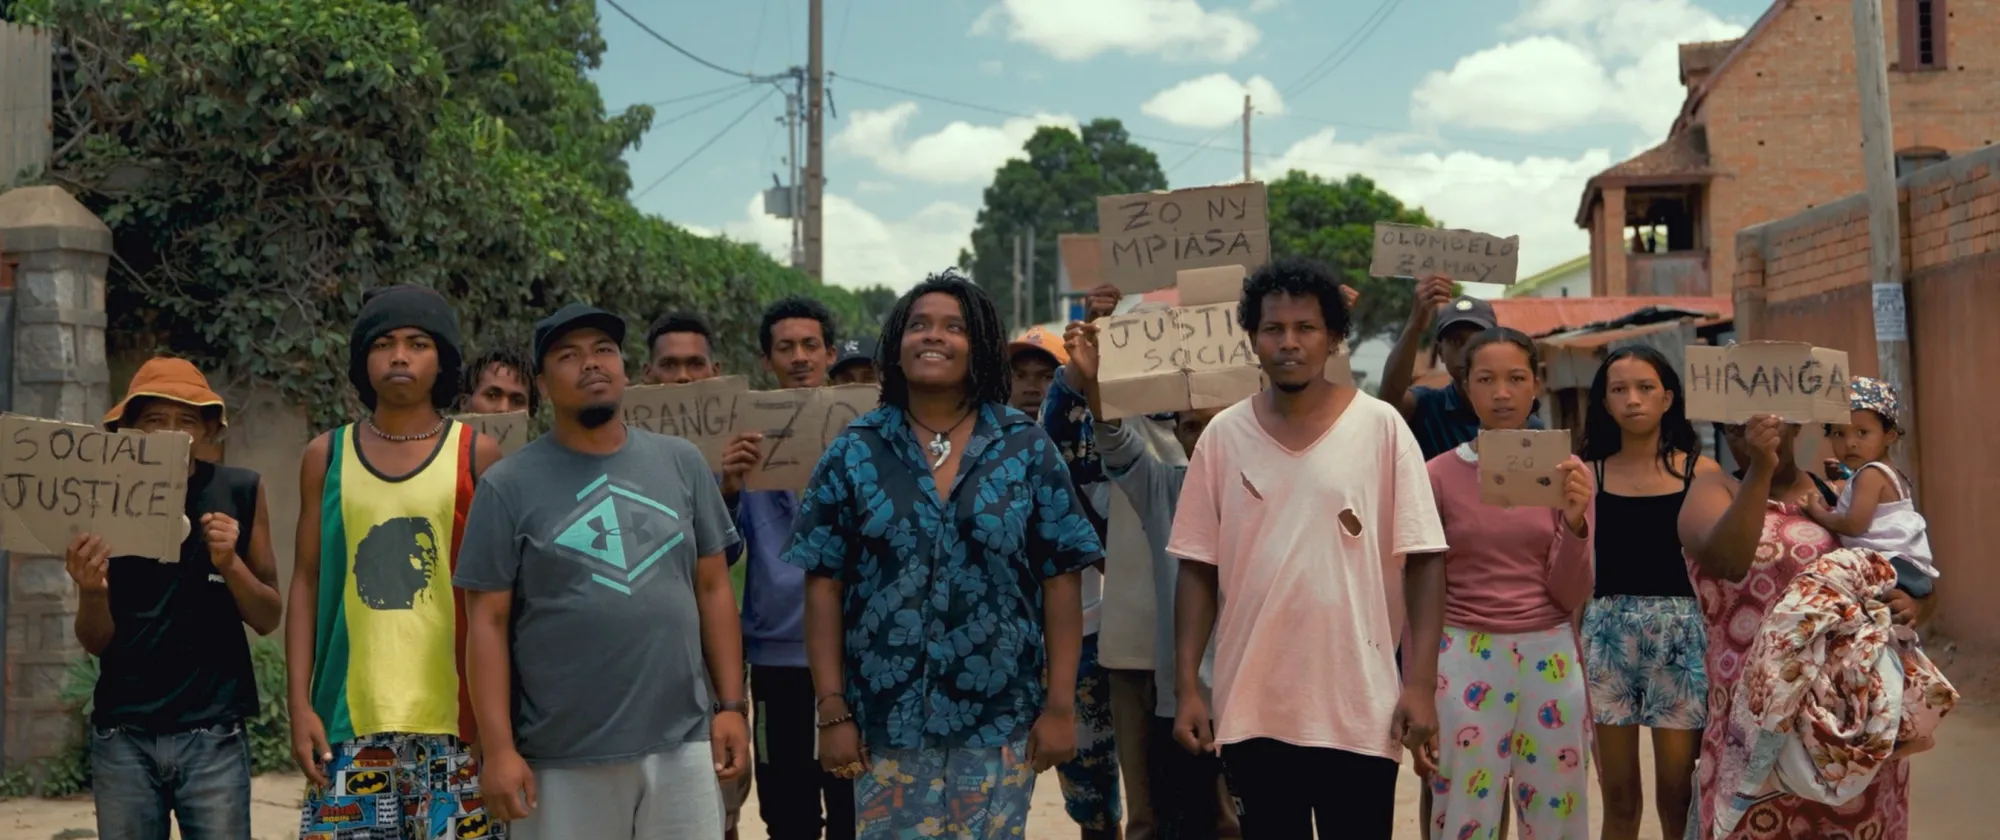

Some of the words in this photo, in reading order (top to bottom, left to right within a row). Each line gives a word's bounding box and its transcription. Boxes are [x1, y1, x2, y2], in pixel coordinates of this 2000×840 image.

[1118, 201, 1182, 233] ZO
[1207, 196, 1246, 221] NY
[13, 425, 163, 466] SOCIAL
[1506, 454, 1534, 472] ZO
